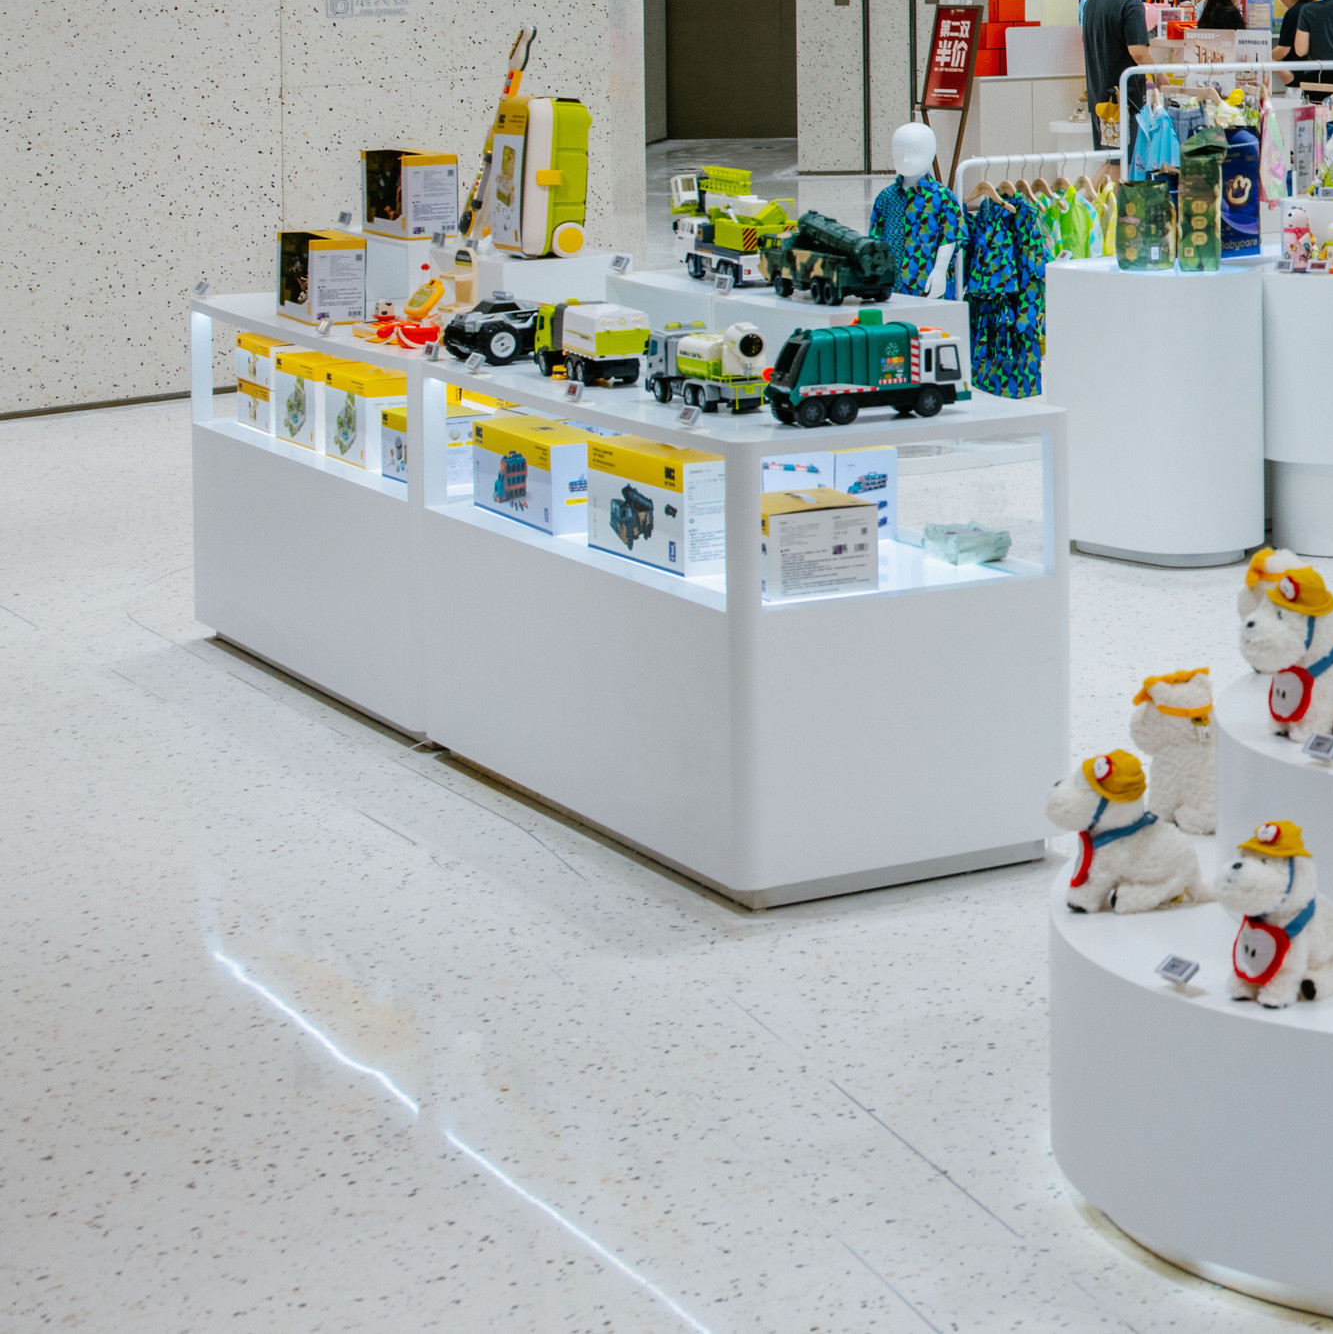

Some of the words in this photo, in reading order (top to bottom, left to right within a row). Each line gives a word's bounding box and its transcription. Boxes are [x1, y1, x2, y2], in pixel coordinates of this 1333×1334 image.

[939, 19, 971, 38] 第二双
[935, 39, 969, 68] 半价
